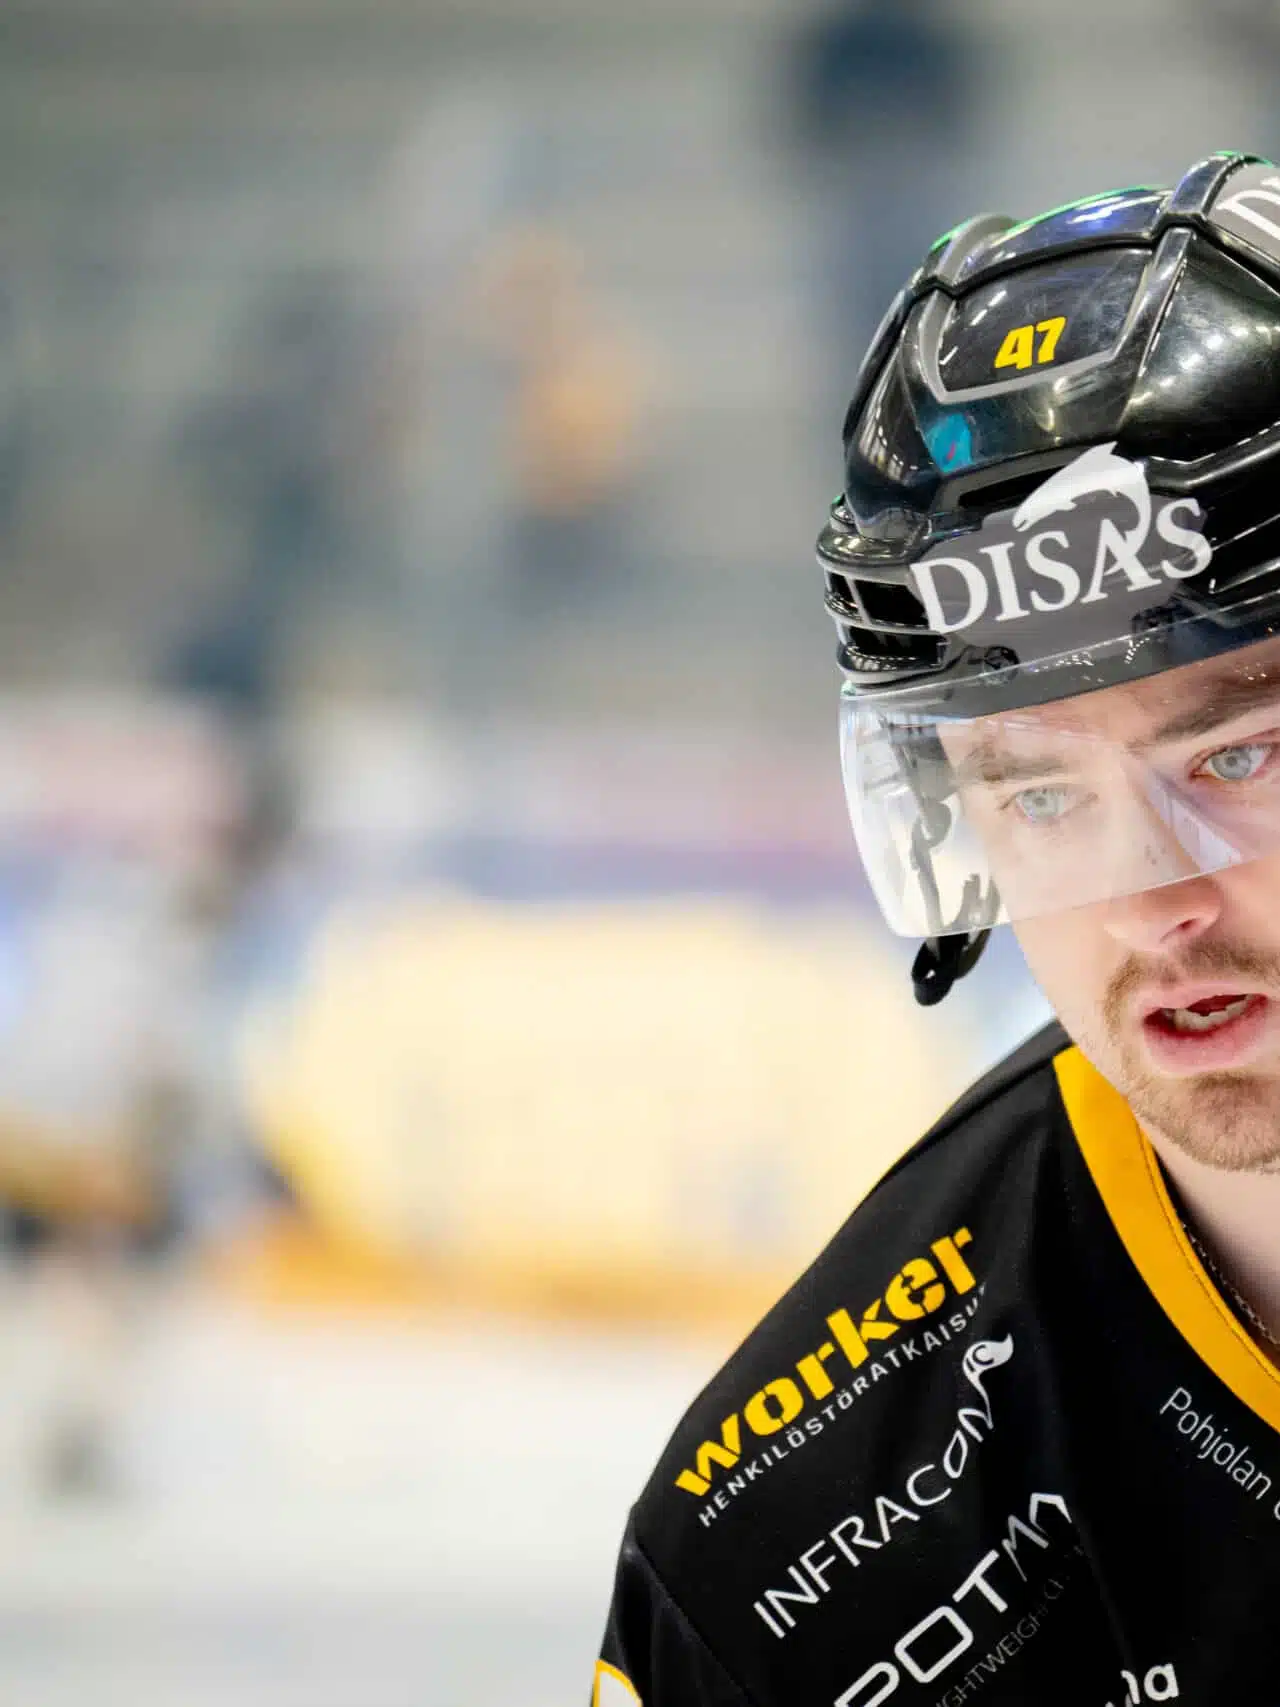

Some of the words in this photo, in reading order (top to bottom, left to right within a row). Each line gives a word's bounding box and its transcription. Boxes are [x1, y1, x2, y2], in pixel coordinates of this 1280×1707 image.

[995, 317, 1066, 369] 47
[911, 498, 1213, 634] DISAS
[674, 1227, 976, 1497] worker
[700, 1282, 986, 1527] HENKILÖSTÖRATKAISU
[1159, 1386, 1272, 1500] Pohjolan
[754, 1362, 994, 1639] INFRACON
